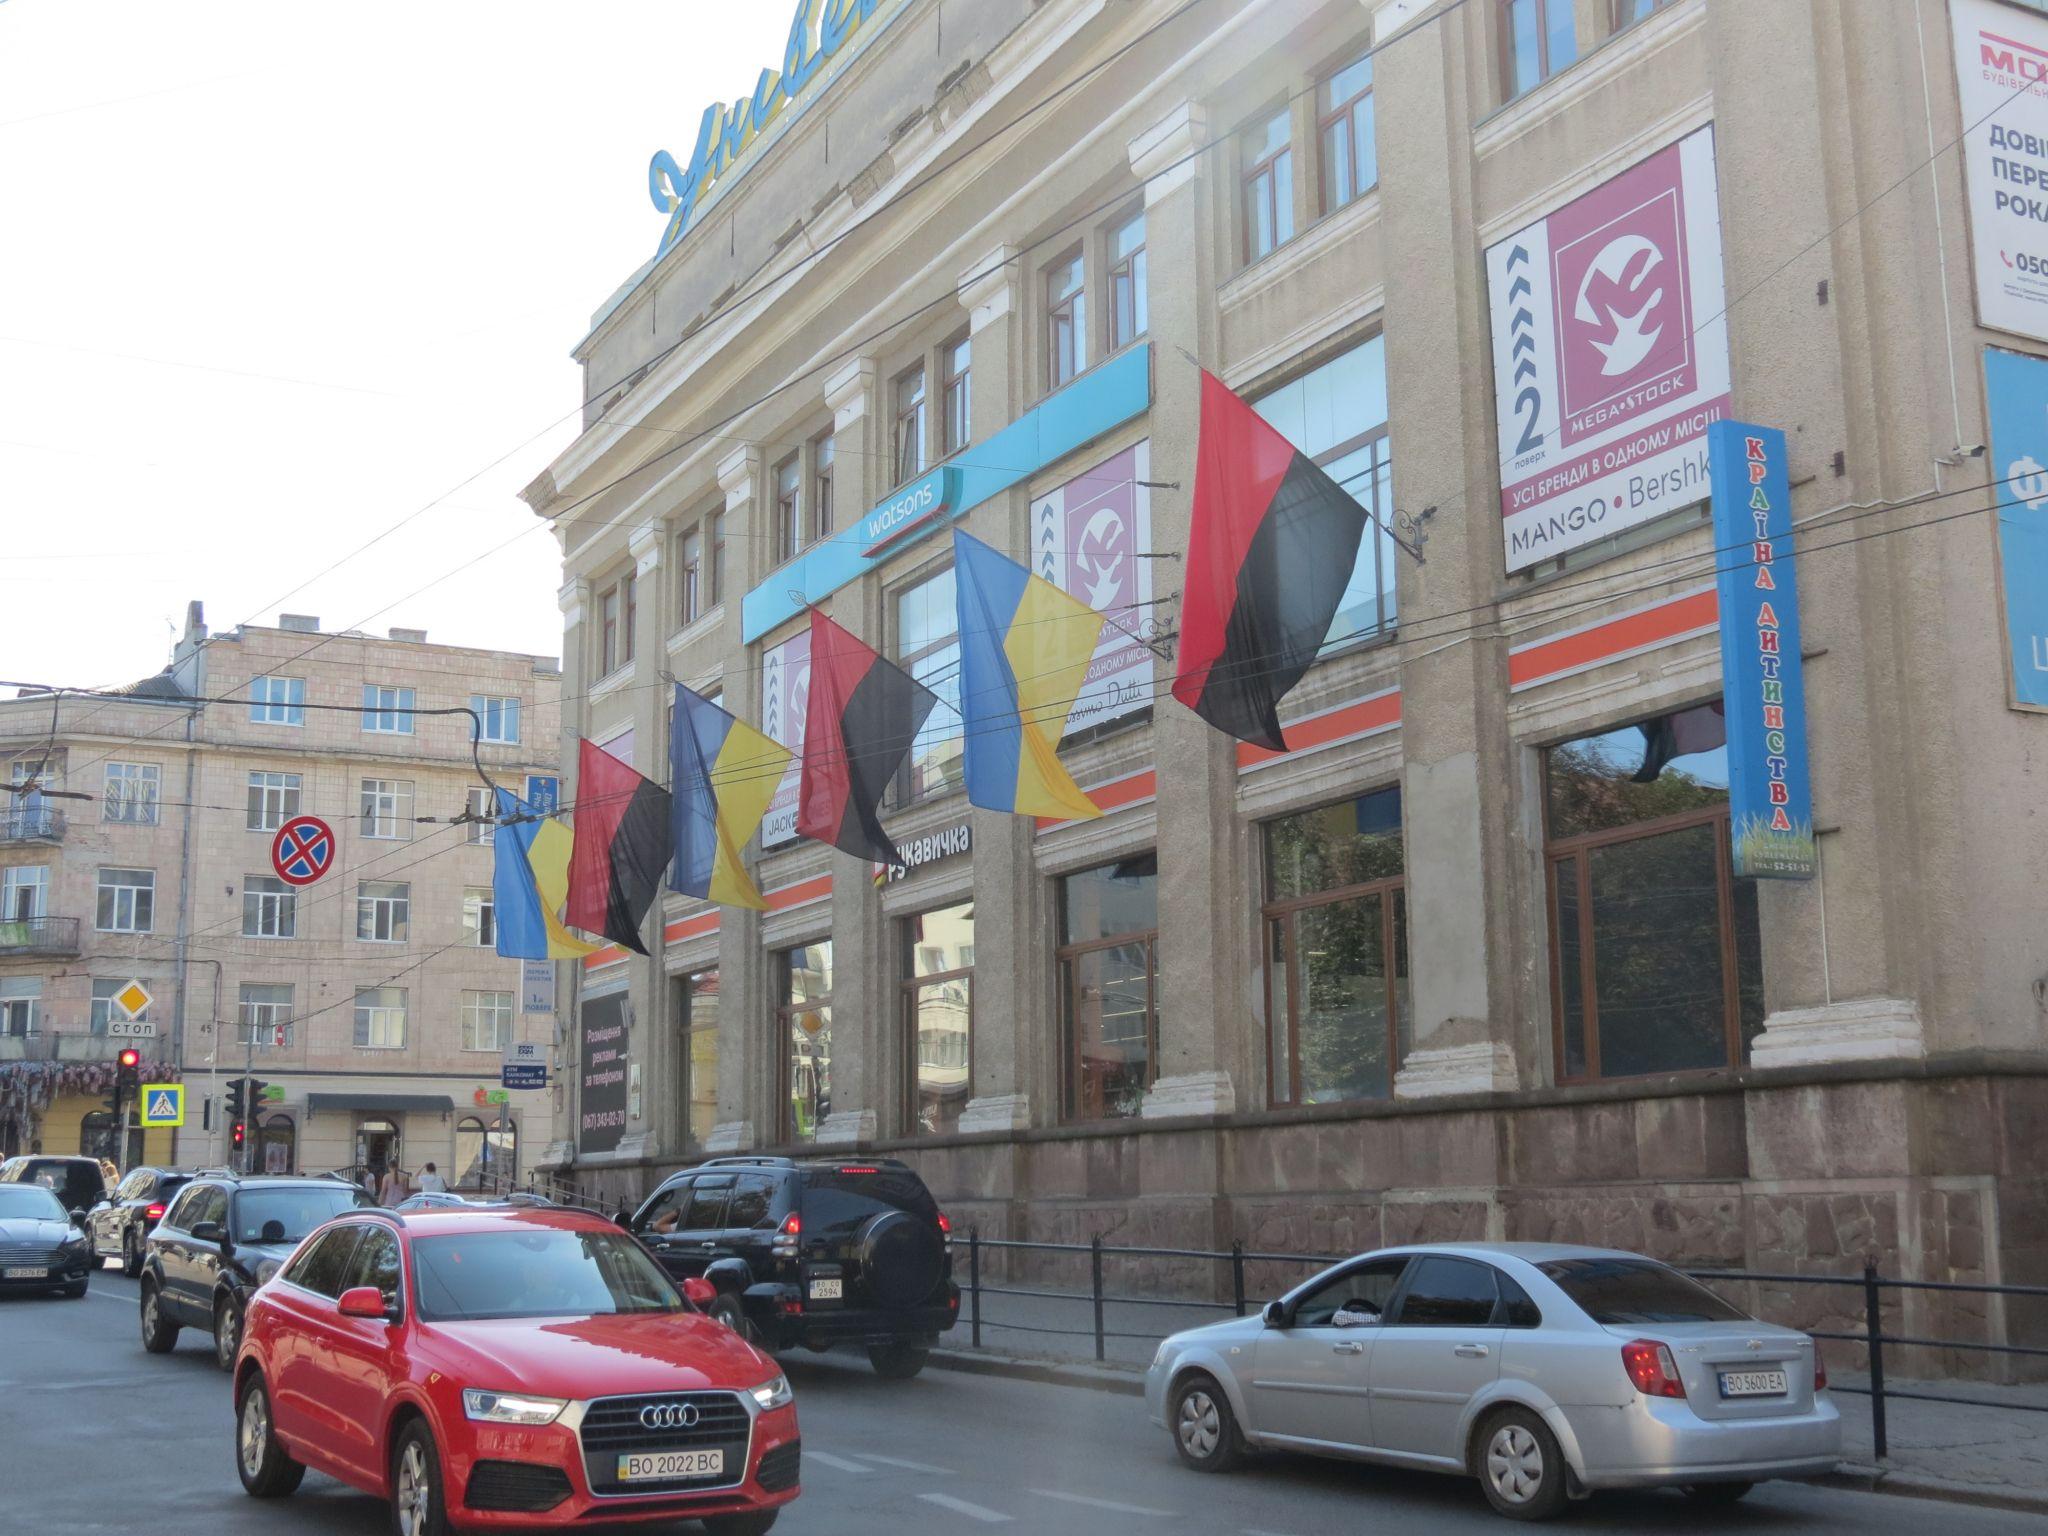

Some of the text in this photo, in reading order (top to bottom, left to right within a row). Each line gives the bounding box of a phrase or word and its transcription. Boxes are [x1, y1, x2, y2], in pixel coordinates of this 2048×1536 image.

[1990, 124, 2048, 158] ДОВІ
[1514, 386, 1544, 456] 2
[1512, 485, 1536, 508] УСІ
[1538, 463, 1589, 497] БРЕНДИ
[1593, 459, 1600, 475] В
[1604, 427, 1672, 468] ОДНОМУ
[1514, 451, 1546, 471] поверх
[869, 483, 932, 538] watsons
[1745, 437, 1776, 590] КРАЇНА
[1511, 498, 1606, 555] MANGO
[1089, 656, 1125, 680] ОДНОМУ
[1107, 679, 1142, 709] Dutti
[1757, 602, 1792, 831] ДИТИНСТВА
[112, 1023, 152, 1034] СТОП
[587, 1026, 622, 1043] Розміщення
[592, 1049, 617, 1068] реклами
[585, 1068, 624, 1087] за телефоном
[583, 1110, 625, 1132] (067) 343-02-70
[1744, 1374, 1768, 1391] 5600
[1769, 1374, 1784, 1389] EA
[629, 1457, 653, 1475] BO
[657, 1455, 694, 1474] 2022
[698, 1453, 720, 1471] BC
